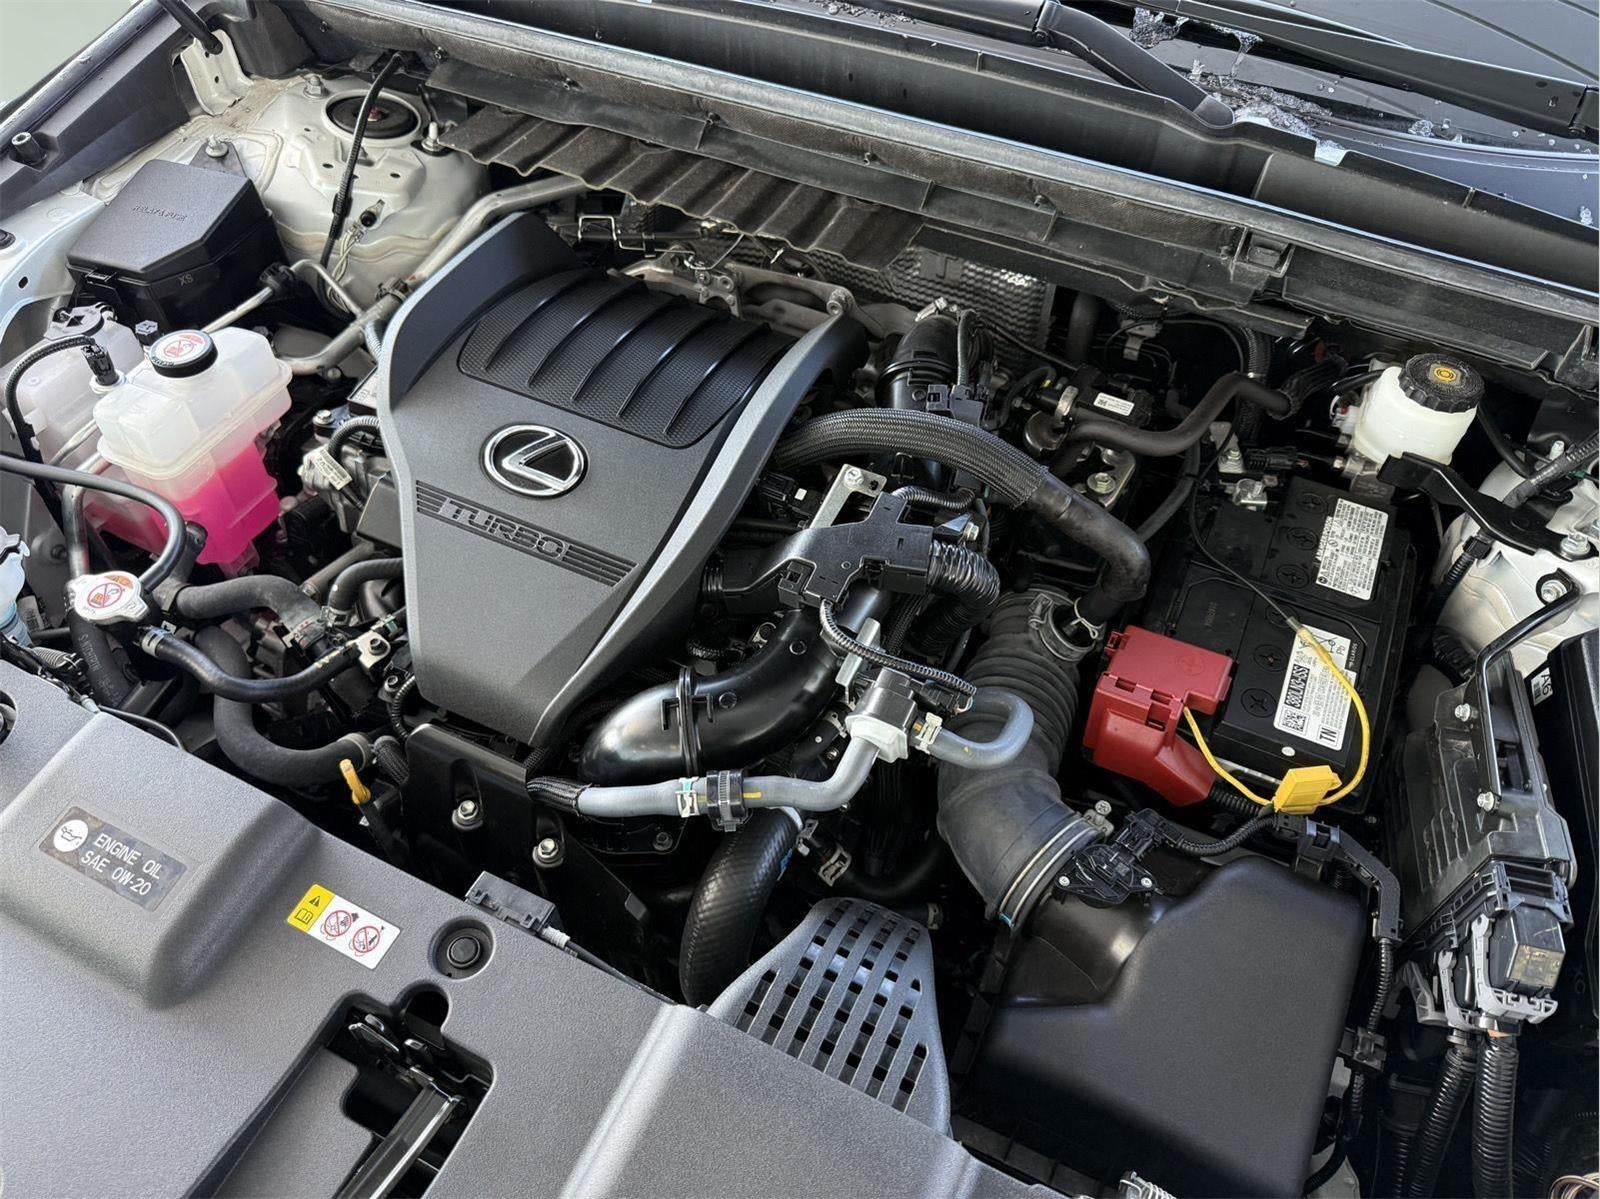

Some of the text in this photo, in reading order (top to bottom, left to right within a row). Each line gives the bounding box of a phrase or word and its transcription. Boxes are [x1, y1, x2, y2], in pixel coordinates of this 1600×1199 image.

[446, 498, 567, 562] TURBO
[1320, 727, 1337, 742] TN
[80, 850, 152, 896] SAE 0W-20
[94, 832, 163, 880] ENGINE OIL
